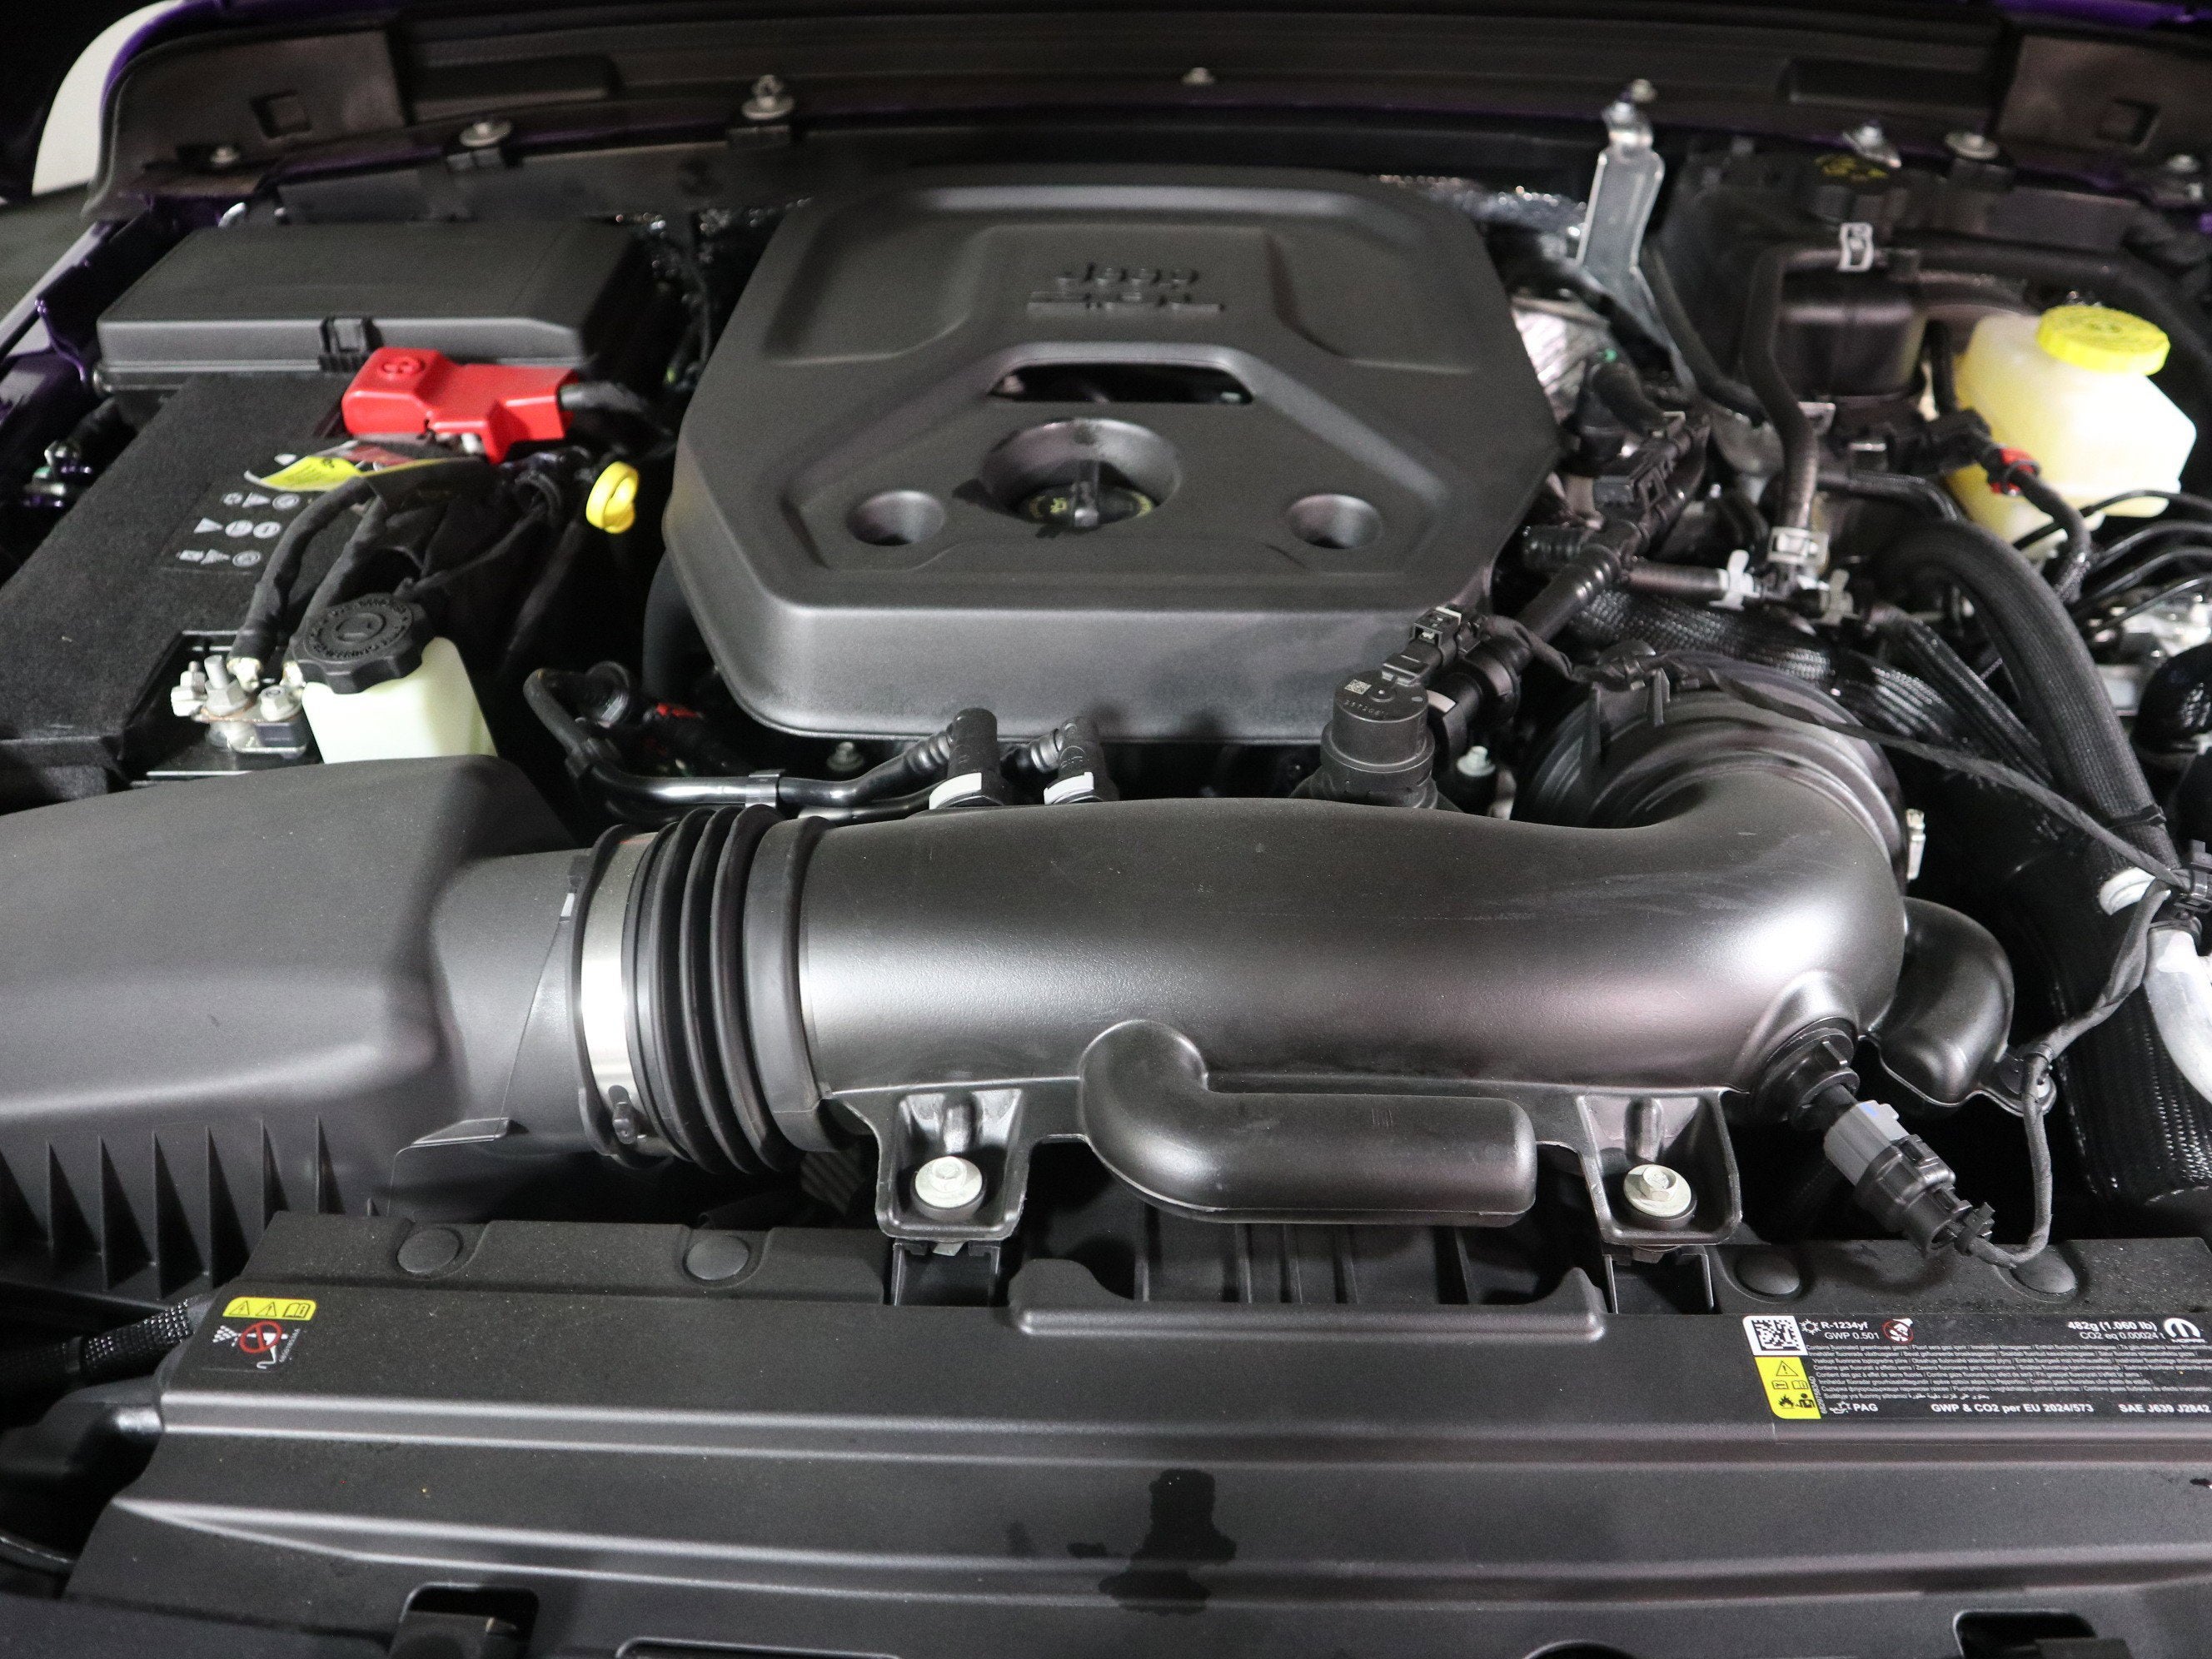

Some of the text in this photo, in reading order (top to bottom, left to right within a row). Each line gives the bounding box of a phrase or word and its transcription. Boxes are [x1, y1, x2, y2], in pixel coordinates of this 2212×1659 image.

[1821, 1322, 1869, 1331] R-1234yf
[2067, 1321, 2158, 1332] 482g (1.060 lb)
[2105, 1333, 2120, 1342] eq
[1853, 1403, 1879, 1412] PAG
[1931, 1403, 2095, 1414] GWP & CO2 per EU 2024/573
[2118, 1404, 2212, 1412] SAE J639 J2842
